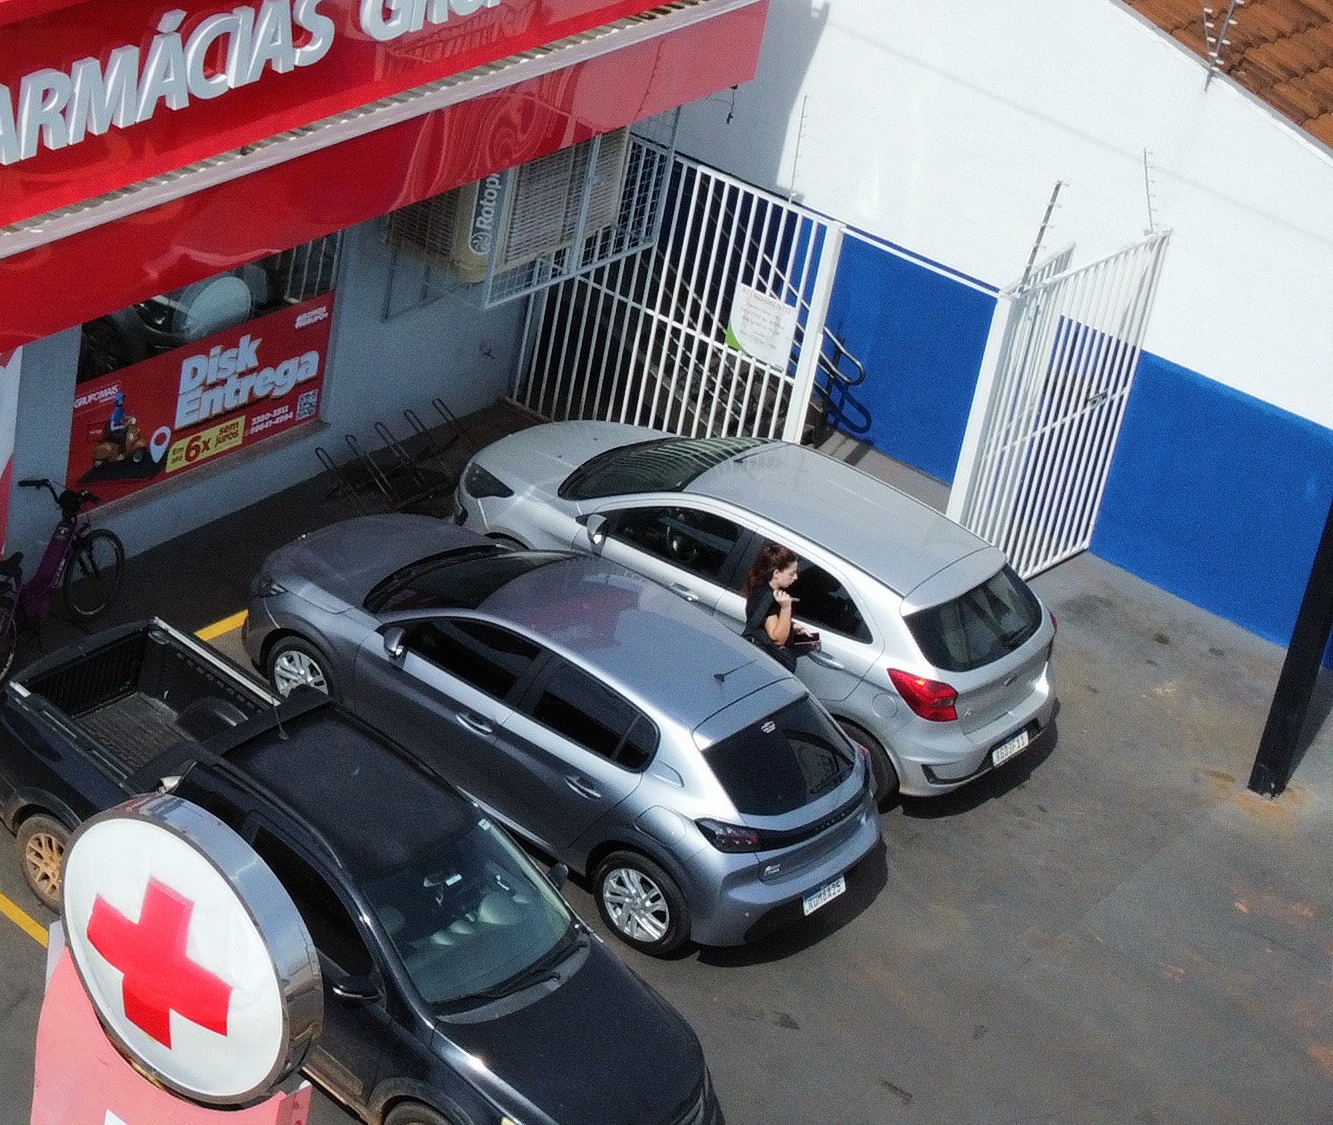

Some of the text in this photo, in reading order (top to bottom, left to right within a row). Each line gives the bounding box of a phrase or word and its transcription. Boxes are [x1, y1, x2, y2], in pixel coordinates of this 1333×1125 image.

[174, 350, 321, 430] Entrega
[179, 334, 262, 395] Disk
[184, 434, 212, 463] 6x
